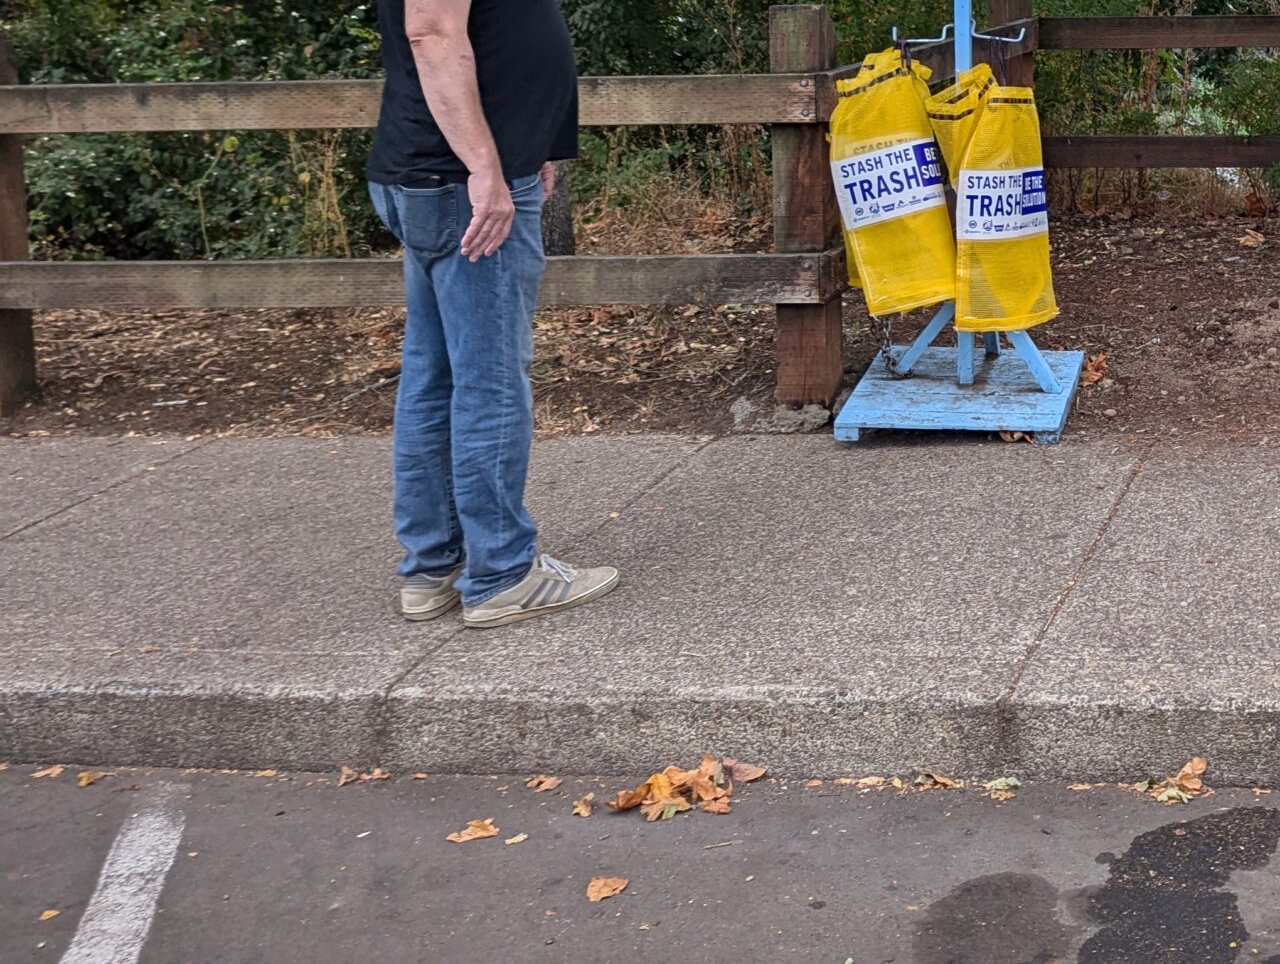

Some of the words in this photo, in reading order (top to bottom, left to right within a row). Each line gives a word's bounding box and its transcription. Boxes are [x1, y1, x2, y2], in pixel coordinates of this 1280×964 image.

[840, 156, 884, 178] STASH
[885, 148, 913, 166] THE
[923, 147, 937, 162] BE
[843, 166, 921, 205] TRASH
[967, 175, 1006, 189] STASH
[1008, 174, 1022, 189] THE
[1024, 177, 1032, 191] BE
[1031, 175, 1043, 190] THE
[965, 193, 1022, 217] TRASH
